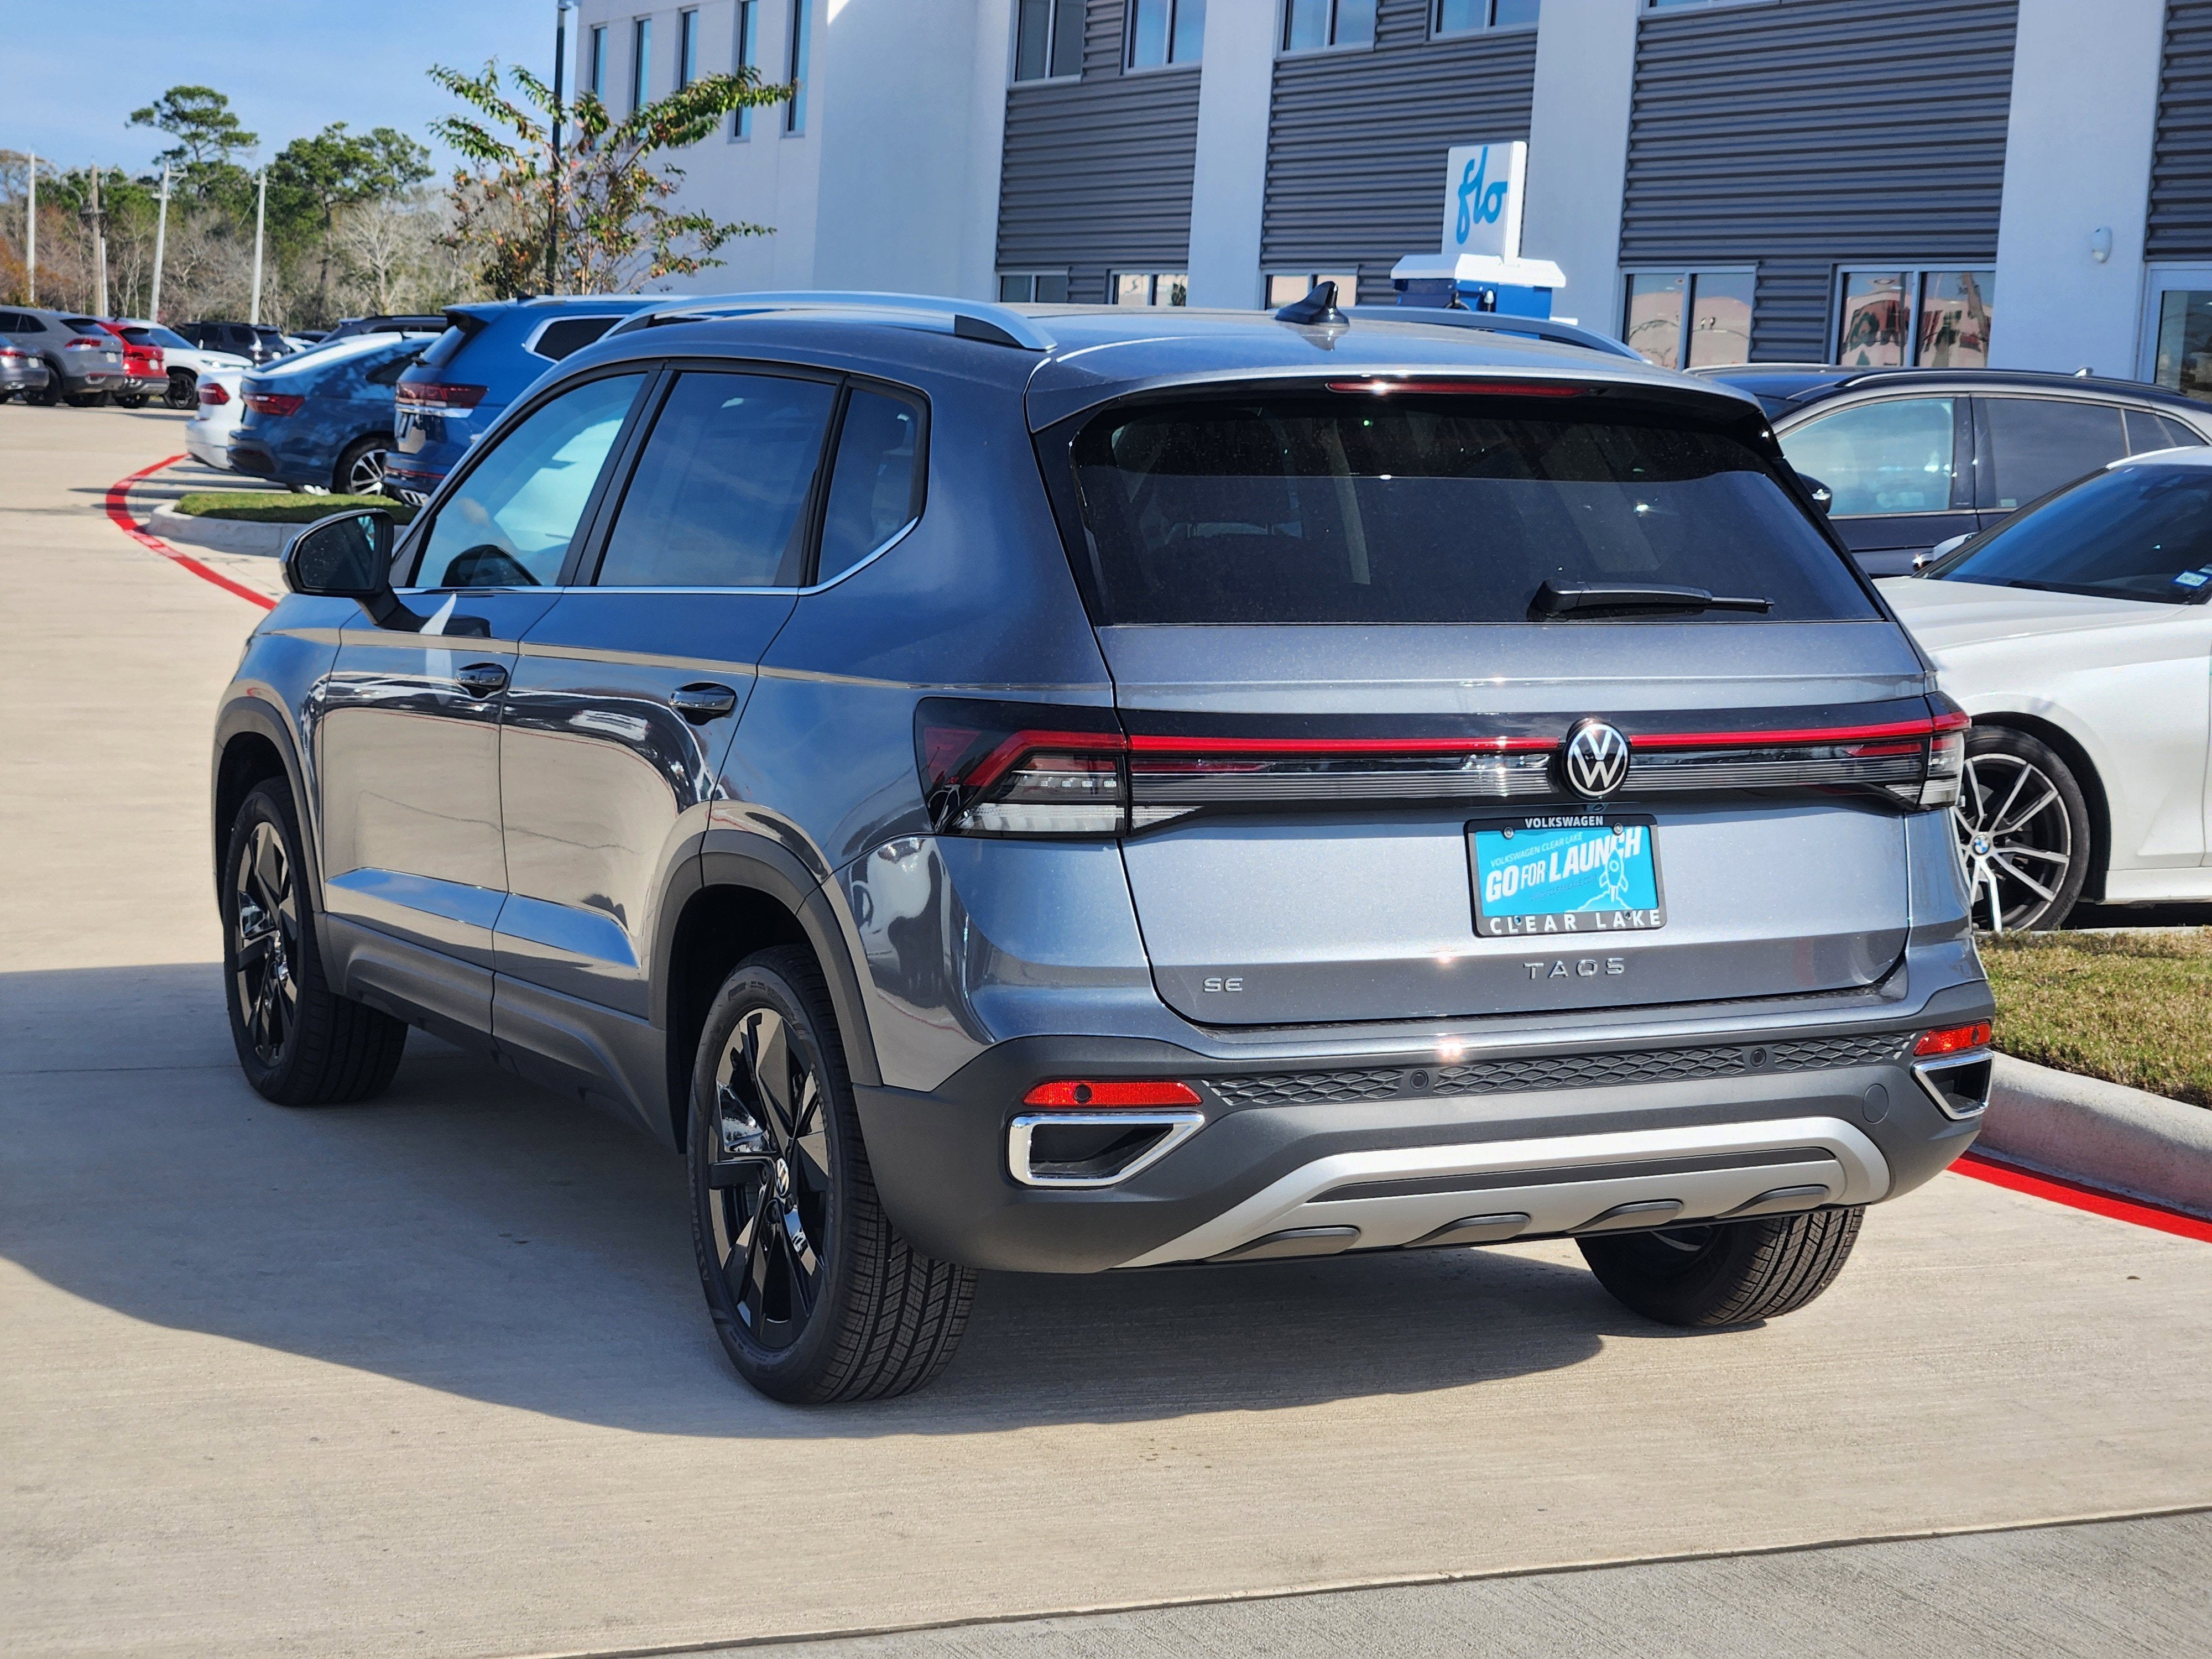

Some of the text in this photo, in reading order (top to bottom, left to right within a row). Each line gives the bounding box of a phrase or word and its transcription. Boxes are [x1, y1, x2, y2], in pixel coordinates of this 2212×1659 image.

[1456, 145, 1508, 244] flo
[1568, 726, 1627, 795] VW
[1525, 816, 1604, 828] VOLKSWAGEN
[1485, 826, 1642, 902] GO FOR LAUNCH
[1490, 831, 1583, 867] VOLKSWAGEN CLEAR LAKE
[1490, 909, 1661, 934] CLEAR LAKE
[1523, 958, 1625, 979] TAOS
[1203, 977, 1243, 992] SE
